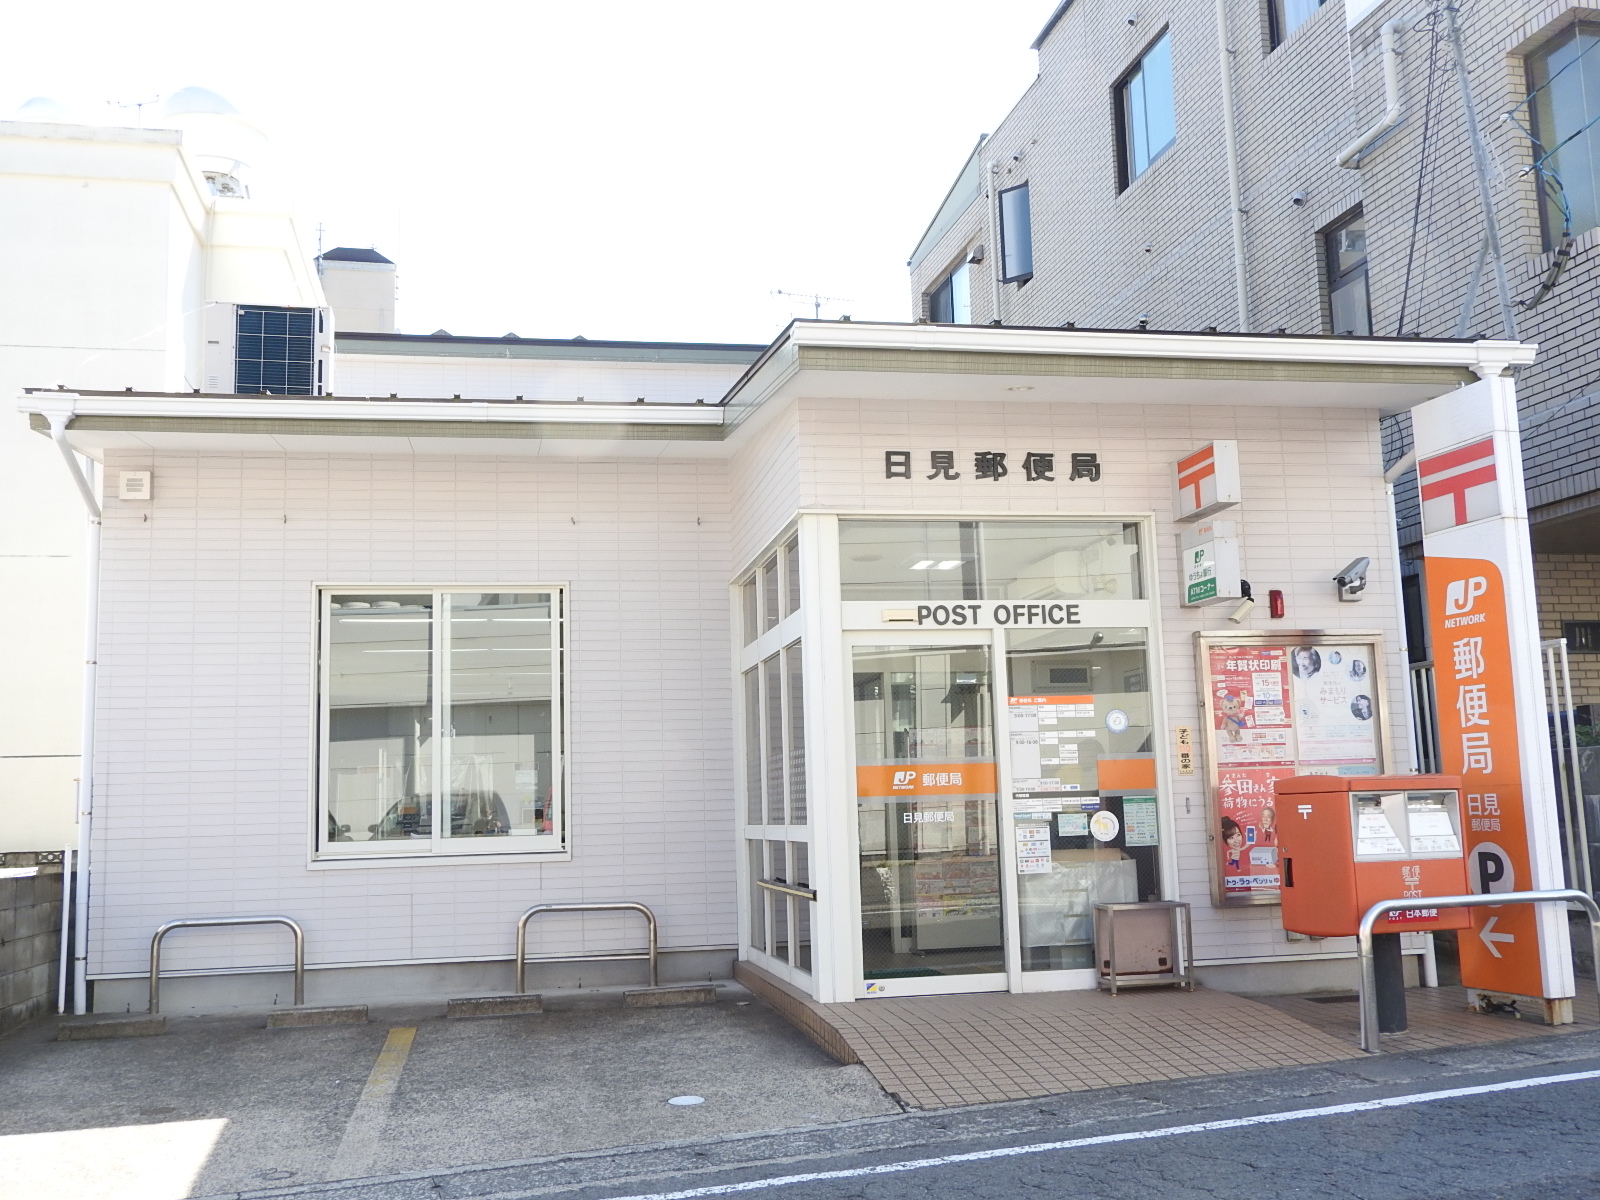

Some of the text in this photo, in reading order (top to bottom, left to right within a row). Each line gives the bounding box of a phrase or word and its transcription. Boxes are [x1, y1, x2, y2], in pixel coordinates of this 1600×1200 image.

[885, 450, 1101, 482] 日見郵便局
[1189, 566, 1212, 582] ゆうちょ銀行
[1190, 582, 1215, 596] ATMコーナー
[917, 604, 1081, 626] POST OFFICE
[1444, 612, 1486, 629] NETWORK
[1226, 659, 1281, 672] 年賀状印刷
[1319, 687, 1346, 695] みまもり
[1319, 696, 1347, 704] サービス
[1452, 636, 1493, 775] 郵便局
[922, 772, 962, 787] 郵便局
[1467, 792, 1500, 816] 日見
[903, 811, 955, 824] 日見郵便局
[1471, 817, 1501, 832] 郵便局
[1401, 865, 1421, 879] 郵便
[1477, 851, 1504, 894] P
[1403, 890, 1422, 899] POST
[1406, 908, 1438, 919] 日本郵便
